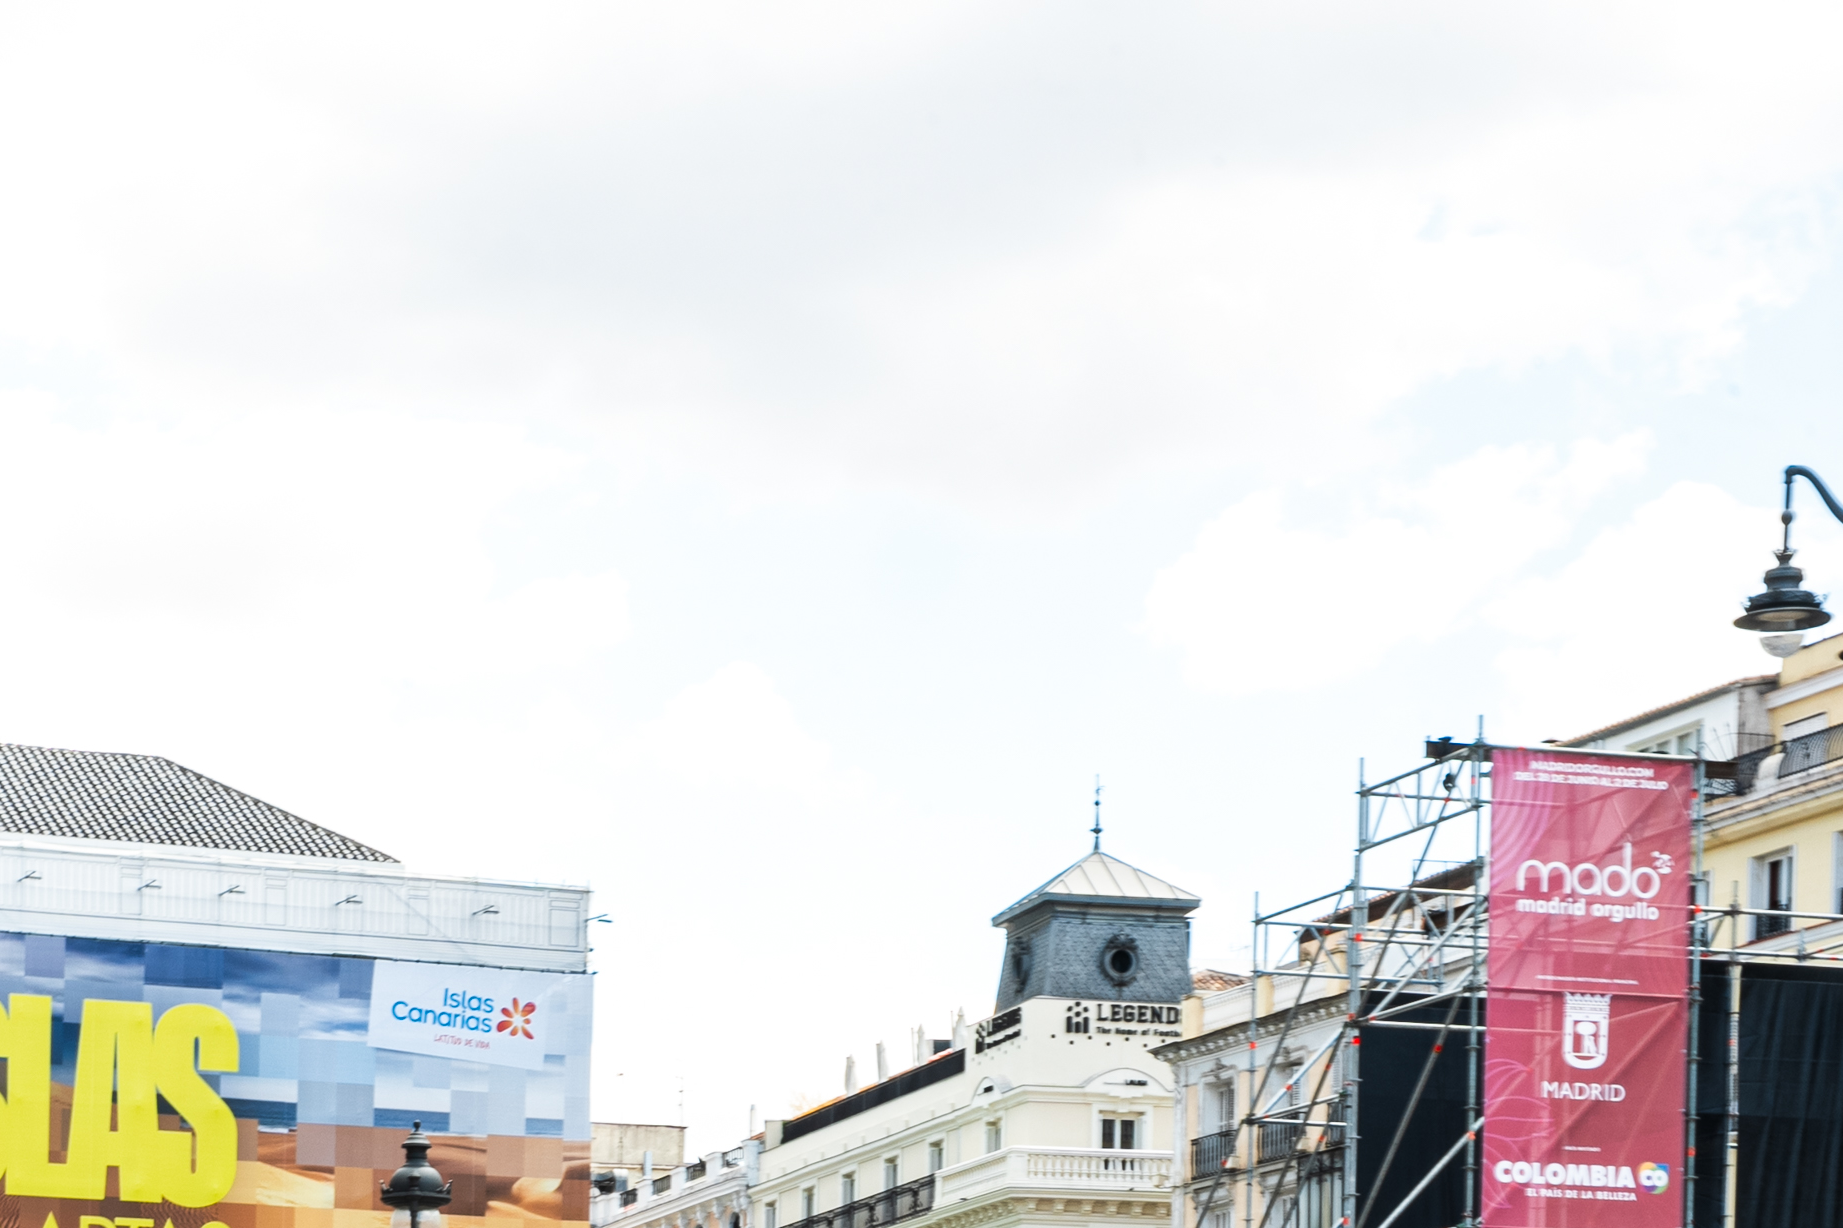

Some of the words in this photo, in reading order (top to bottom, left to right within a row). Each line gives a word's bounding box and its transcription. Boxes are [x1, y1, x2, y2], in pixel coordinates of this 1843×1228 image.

[1516, 842, 1661, 899] mado
[1515, 896, 1586, 916] madrid
[1590, 901, 1660, 923] orgullo
[443, 988, 494, 1014] Islas
[1096, 1003, 1181, 1025] LEGEND
[391, 1000, 493, 1033] Canarias
[1096, 1026, 1112, 1034] The
[1115, 1027, 1138, 1036] Home
[1541, 1081, 1626, 1102] MADRID
[1494, 1160, 1636, 1188] COLOMBIA
[1525, 1187, 1534, 1197] EL
[1539, 1187, 1563, 1198] PAÍS
[1565, 1189, 1578, 1198] DE
[1581, 1190, 1594, 1199] LA
[1596, 1191, 1637, 1201] BELLEZA
